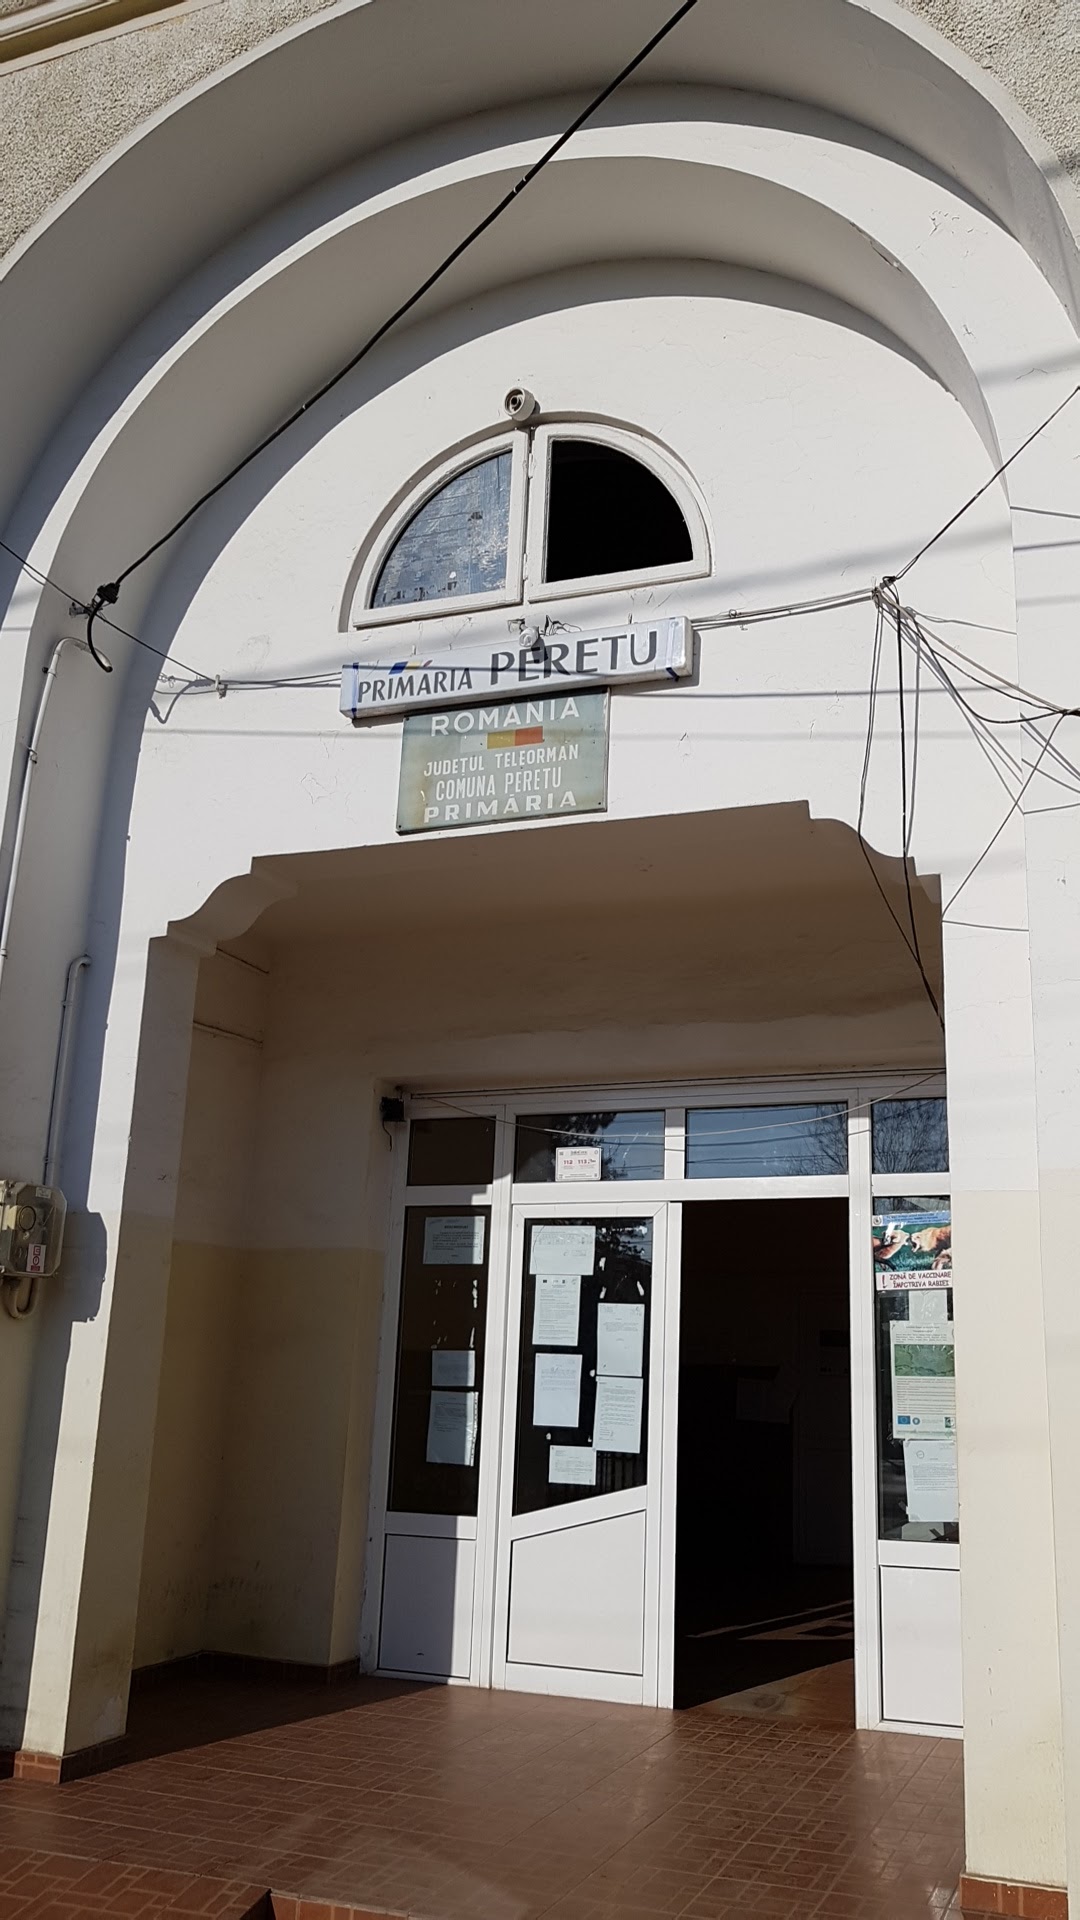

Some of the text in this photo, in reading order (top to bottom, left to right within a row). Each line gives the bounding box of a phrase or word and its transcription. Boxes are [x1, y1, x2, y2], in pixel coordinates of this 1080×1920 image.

[490, 631, 658, 686] PERETU
[495, 744, 579, 769] TELEORMAN
[435, 766, 562, 801] COMUNA PERETU
[423, 790, 577, 824] PRIMĂRIA
[918, 1271, 952, 1279] VACCINARE
[928, 1279, 950, 1287] RABIEI
